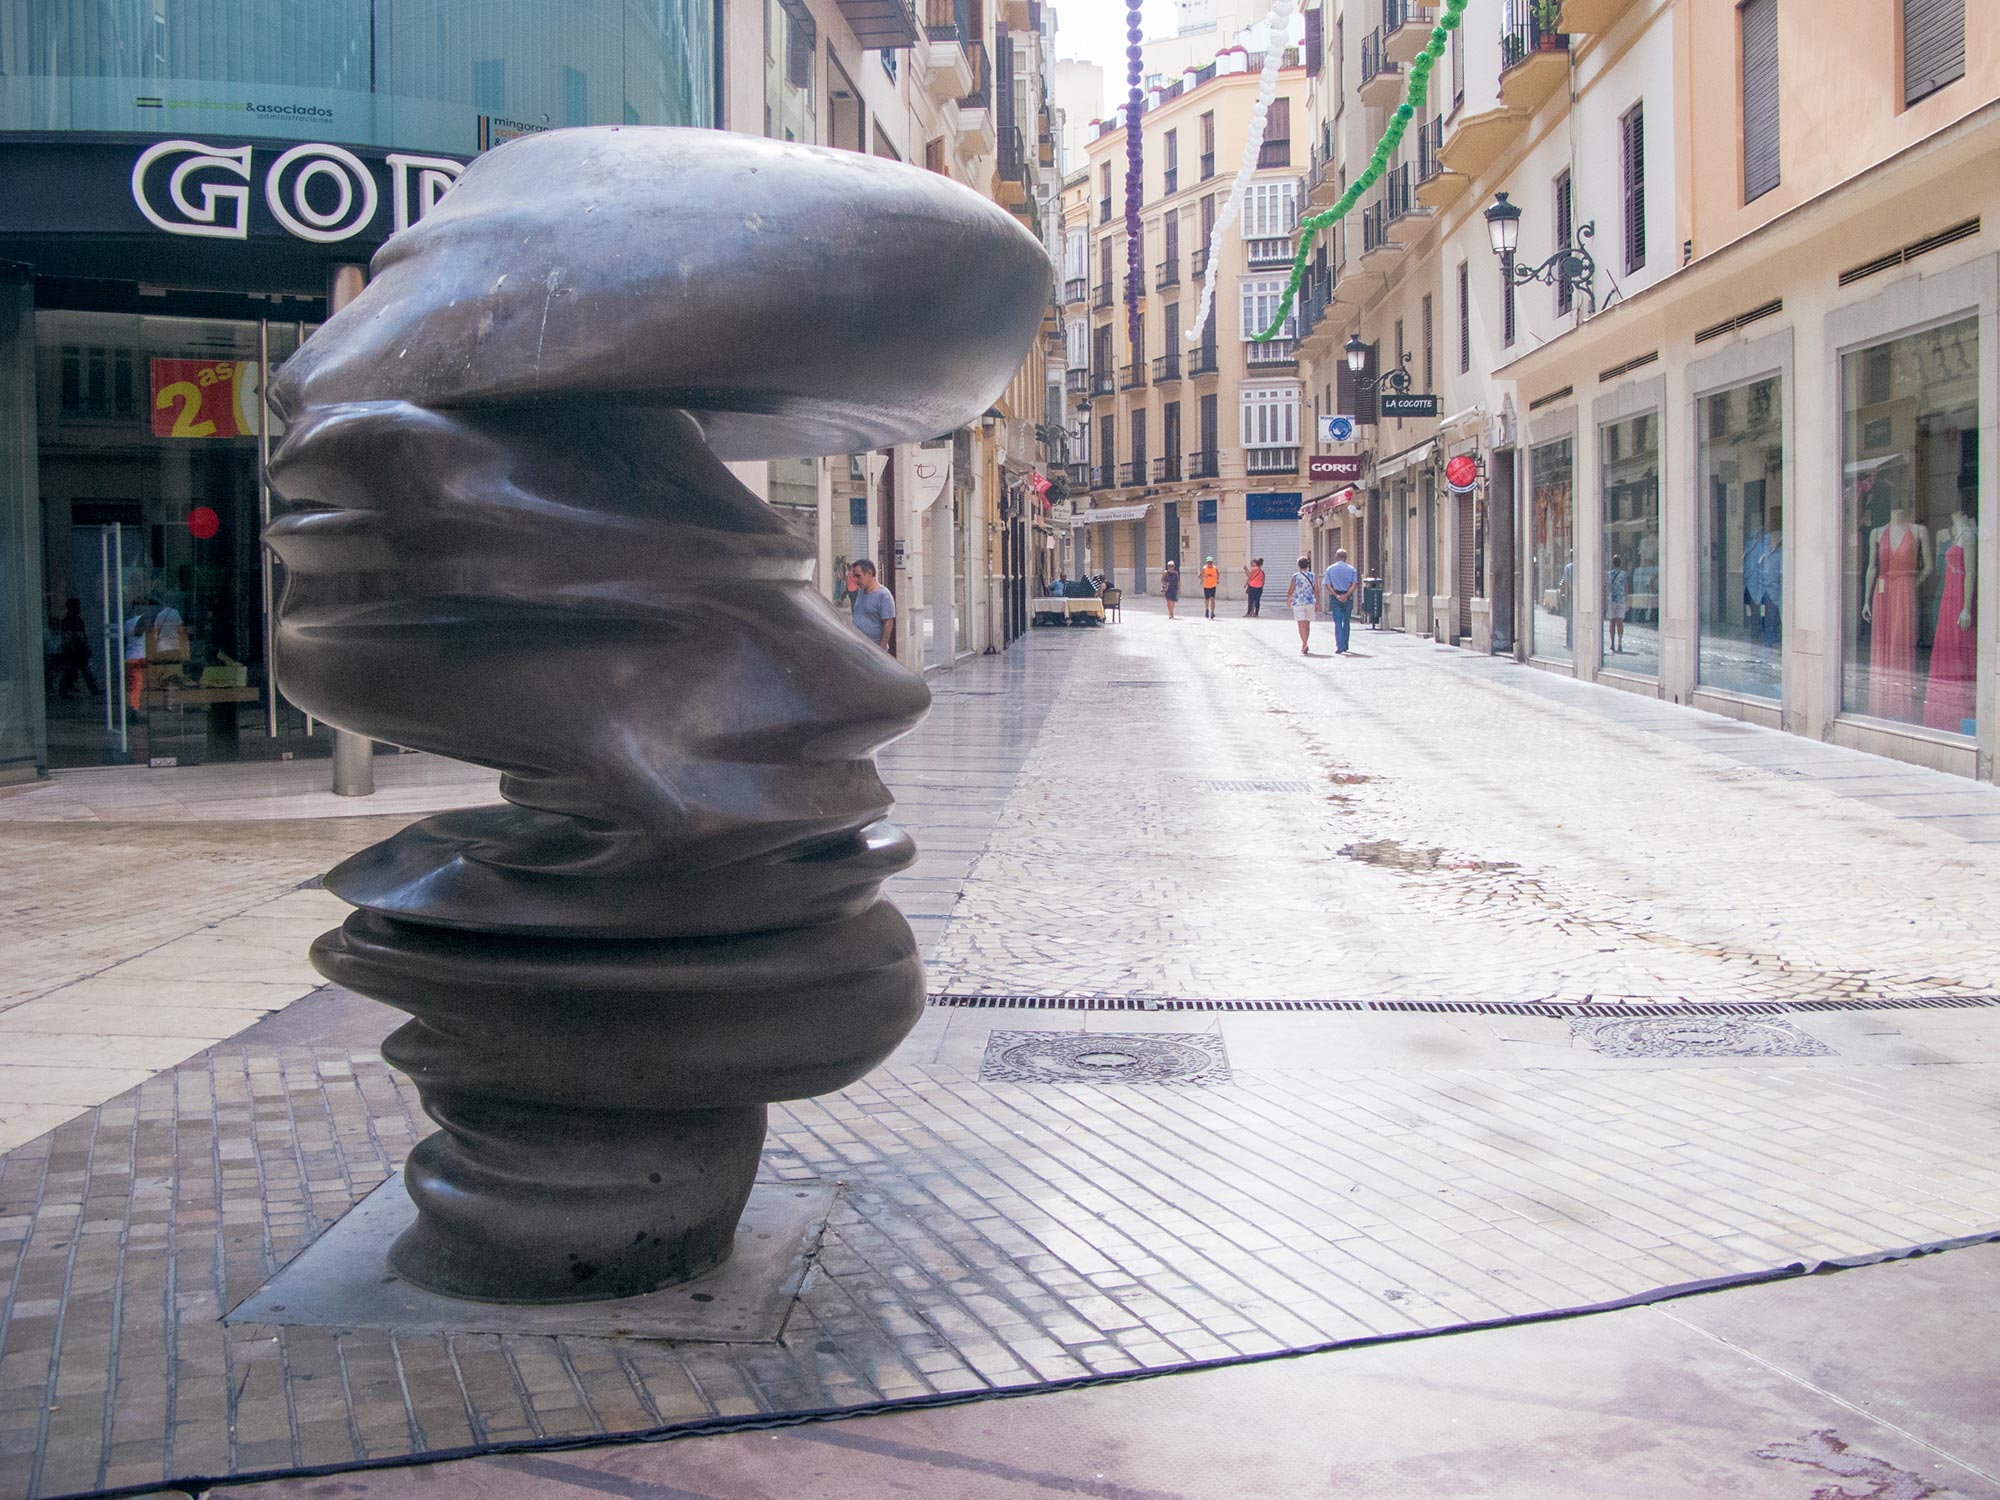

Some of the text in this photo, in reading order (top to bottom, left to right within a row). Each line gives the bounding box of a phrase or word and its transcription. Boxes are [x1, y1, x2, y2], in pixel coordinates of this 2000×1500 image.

[1385, 399, 1433, 408] LA COCOTTE
[1311, 463, 1357, 473] GORKI
